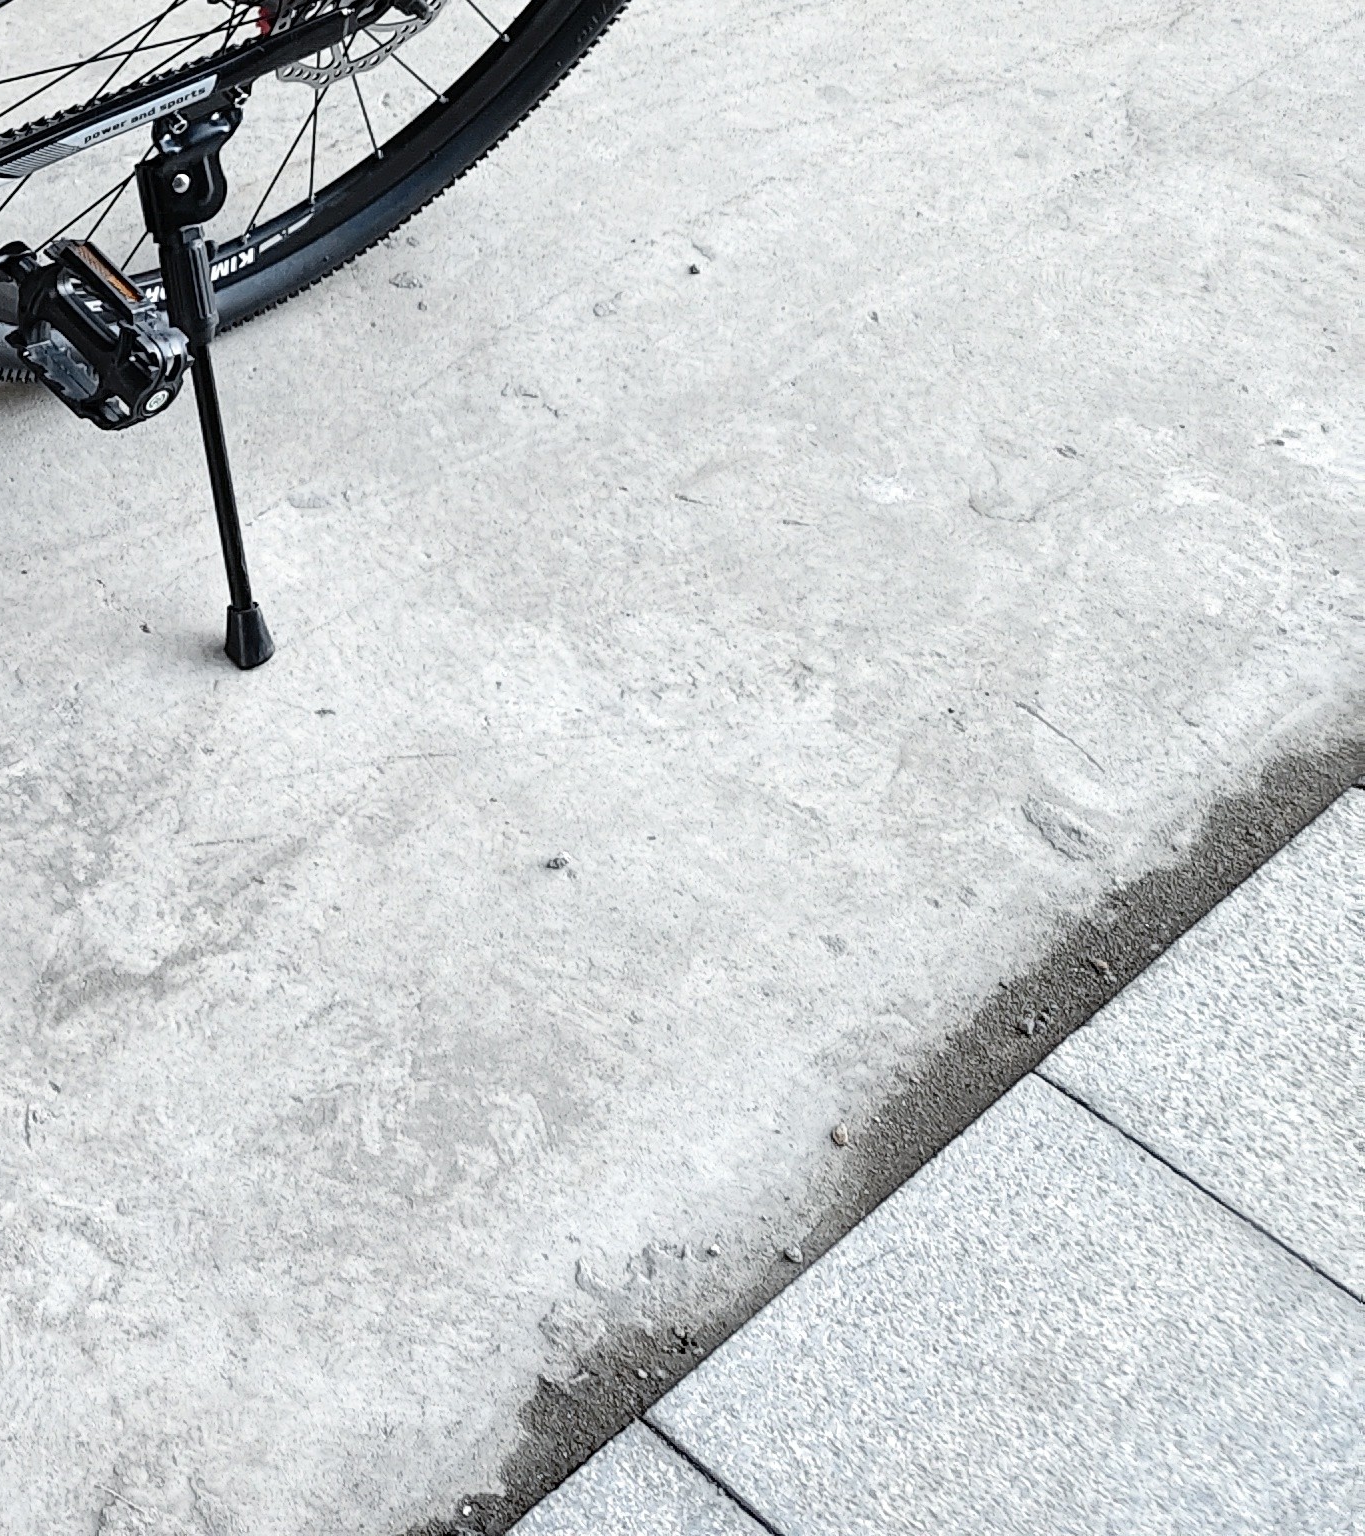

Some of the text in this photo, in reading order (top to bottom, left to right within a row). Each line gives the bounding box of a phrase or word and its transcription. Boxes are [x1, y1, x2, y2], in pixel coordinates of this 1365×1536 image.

[84, 87, 206, 144] power and sports
